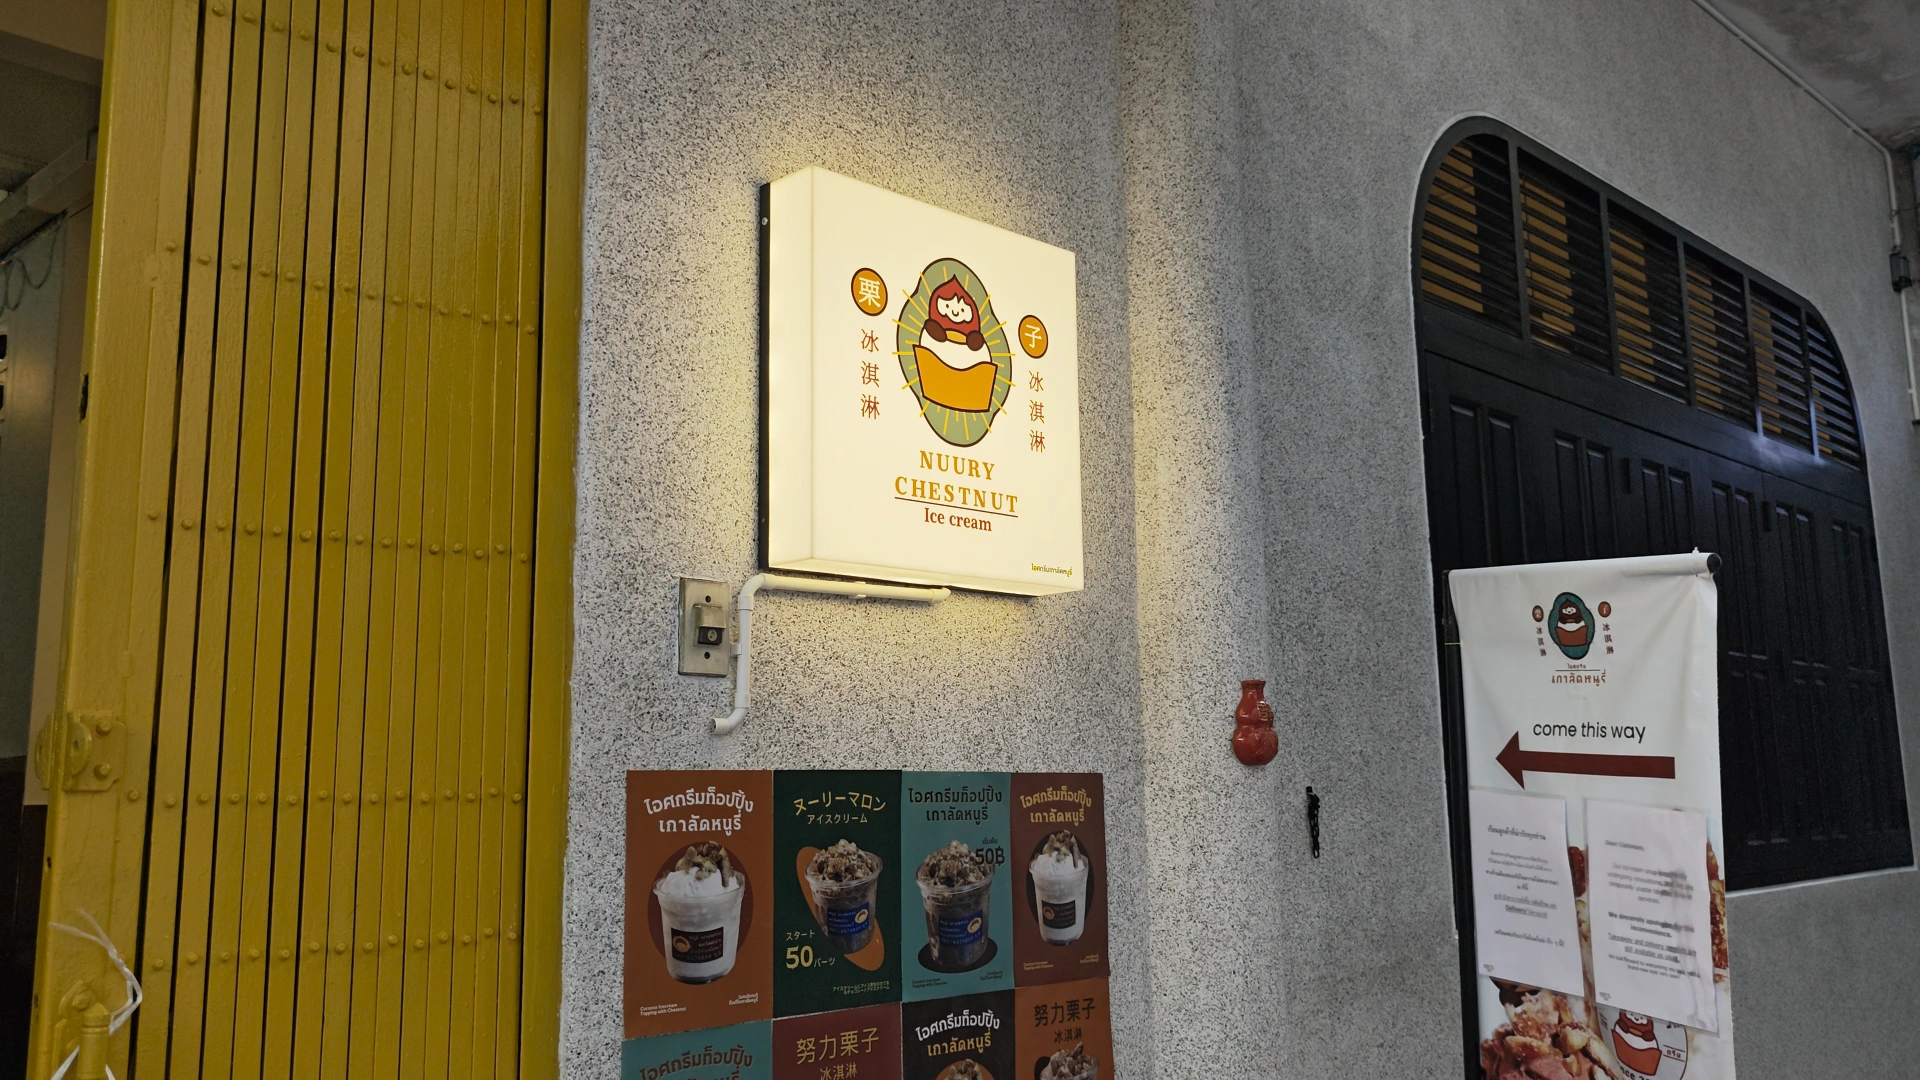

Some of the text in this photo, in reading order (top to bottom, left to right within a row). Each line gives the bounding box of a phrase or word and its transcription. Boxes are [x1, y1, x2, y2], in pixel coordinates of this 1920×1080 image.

[858, 276, 882, 308] 栗
[1024, 324, 1042, 349] 子
[860, 328, 881, 420] 冰淇淋
[1028, 370, 1046, 453] 冰淇淋
[919, 450, 995, 480] NUURY
[894, 476, 1018, 513] CHESTNUT
[924, 507, 992, 532] Ice cream
[1532, 722, 1646, 744] come this way
[643, 786, 754, 815] ไอศกรีมท็อปปิ้ง
[793, 791, 886, 816] ヌーリーマロン
[908, 785, 1002, 804] ไอศกรีมท็อปปิ้ง
[1019, 785, 1092, 809] ไอศกรีมท็อปปิ้ง
[806, 813, 868, 825] アイスクリーム
[1608, 911, 1618, 919] We
[1618, 914, 1645, 924] sincerely
[785, 929, 816, 942] スタート
[915, 1009, 1001, 1042] ไอศกรีมท็อปปิ้ง
[1034, 998, 1096, 1028] 努力栗子
[796, 1027, 880, 1064] 努力栗子
[1053, 1027, 1083, 1044] 冰淇淋
